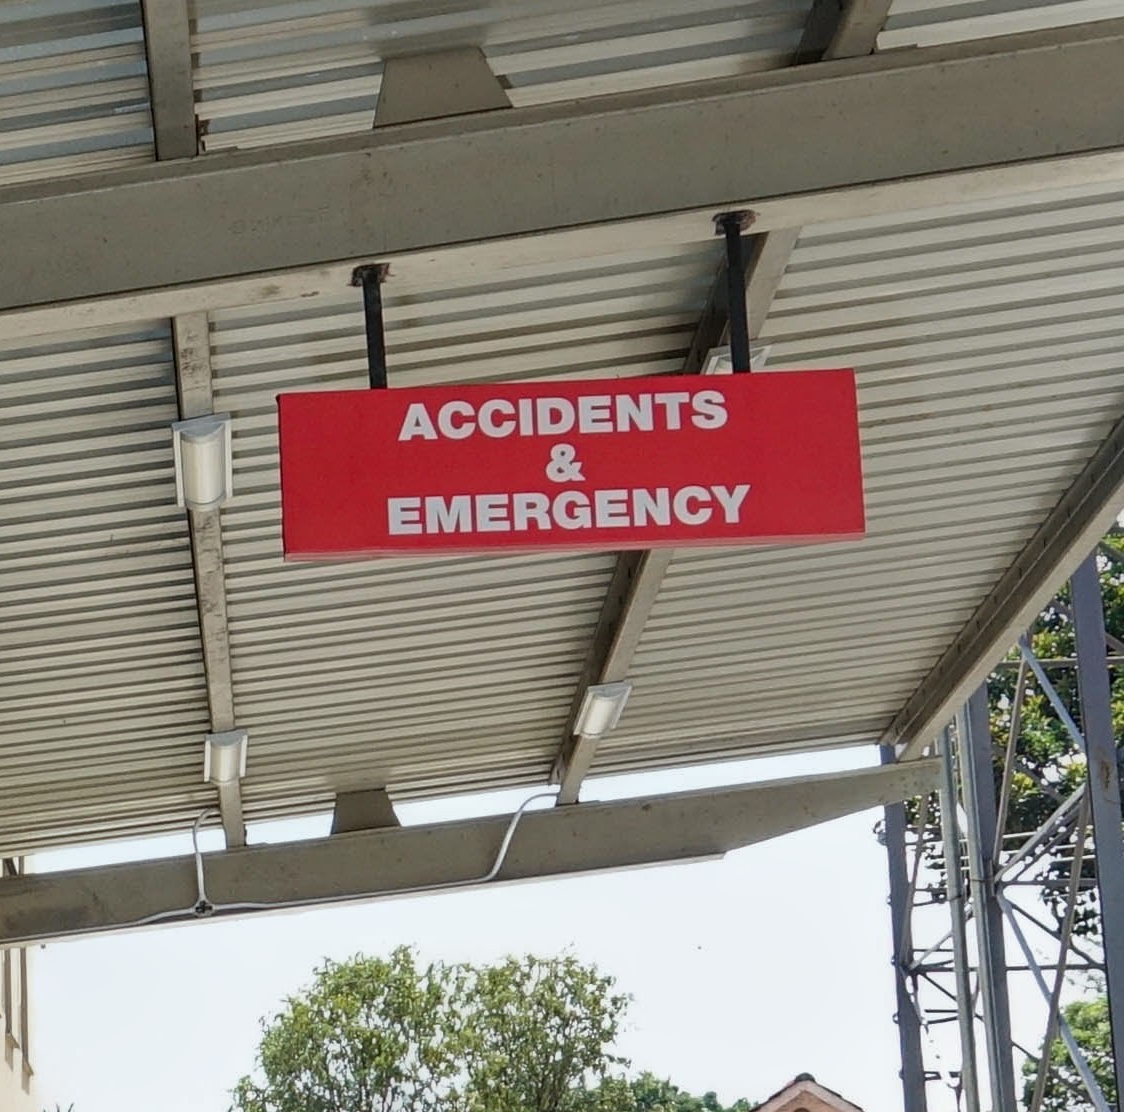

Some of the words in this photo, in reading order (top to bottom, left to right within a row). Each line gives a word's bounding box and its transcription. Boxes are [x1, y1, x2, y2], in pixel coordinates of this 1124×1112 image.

[398, 390, 729, 442] ACCIDENTS
[546, 443, 586, 483] &
[387, 484, 751, 536] EMERGENCY
